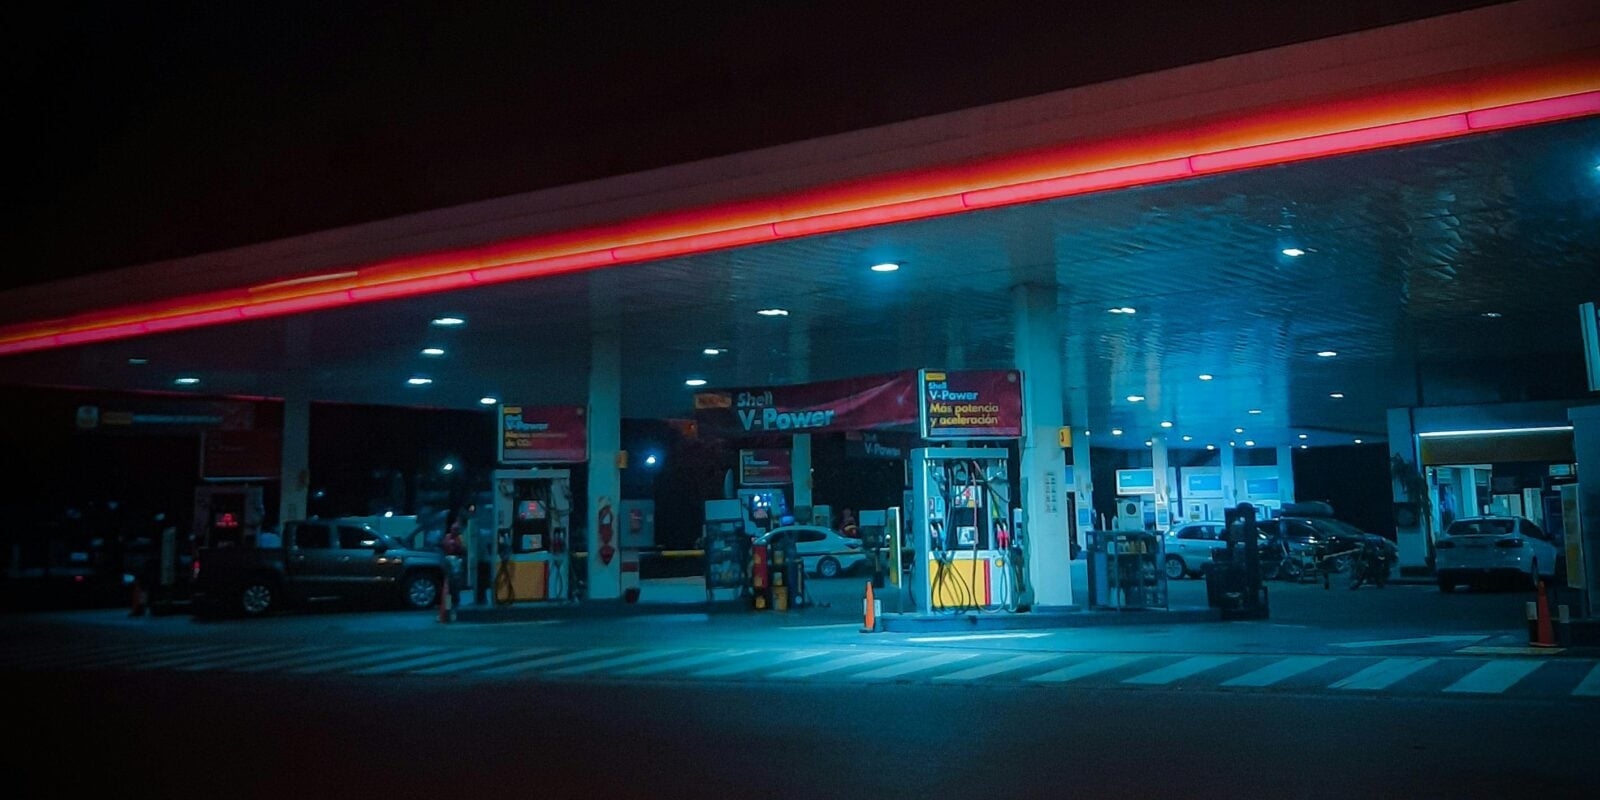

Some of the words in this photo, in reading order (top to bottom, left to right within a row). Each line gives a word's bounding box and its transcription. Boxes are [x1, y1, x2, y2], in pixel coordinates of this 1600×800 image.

[928, 381, 947, 389] Shell
[736, 391, 773, 408] Shell
[929, 390, 979, 400] V-Power
[930, 402, 953, 413] Más
[955, 402, 999, 415] potencia
[737, 407, 837, 432] V-Power
[930, 417, 938, 427] y
[940, 414, 999, 425] aceleración
